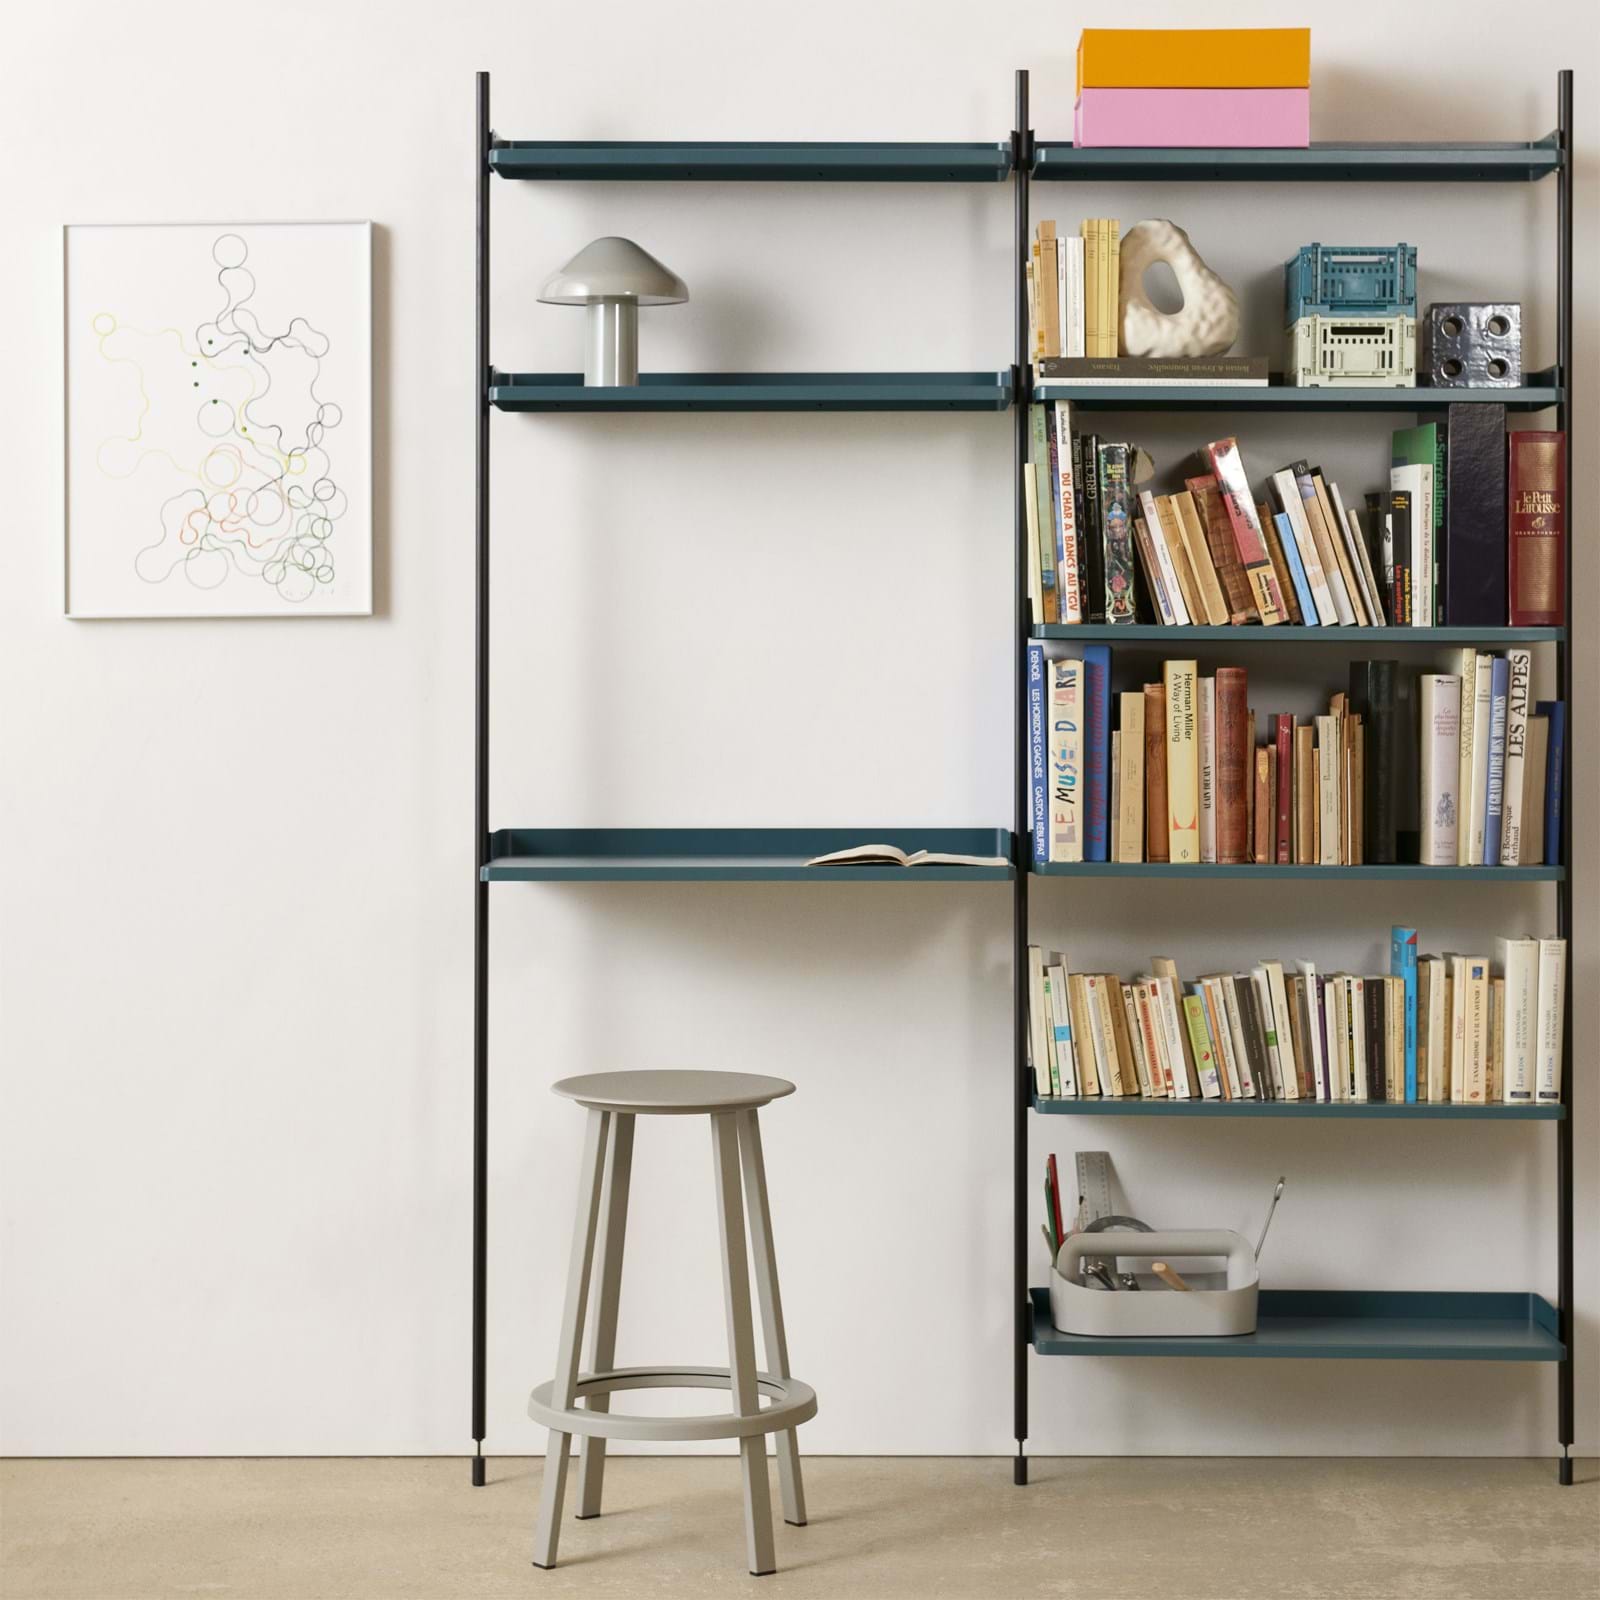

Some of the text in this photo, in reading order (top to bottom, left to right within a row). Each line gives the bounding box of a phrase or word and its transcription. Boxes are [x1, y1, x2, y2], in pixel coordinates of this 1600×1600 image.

[1061, 472, 1071, 487] DU
[1434, 442, 1446, 527] Surréalisme
[1062, 490, 1072, 520] CHAR
[1515, 499, 1561, 514] Larousse
[1523, 491, 1552, 504] le Petit
[1065, 535, 1075, 568] BANCS
[1067, 572, 1077, 587] AU
[1068, 590, 1078, 611] TGV
[1030, 650, 1041, 682] DENOËL
[1032, 688, 1041, 702] LES
[1171, 673, 1182, 743] A Way of Living
[1184, 673, 1193, 740] Herman Miller
[1508, 654, 1529, 759] LES ALPES
[1032, 702, 1042, 744] HORIZONS
[1035, 786, 1044, 821] GASTON
[1055, 809, 1077, 843] LE
[1502, 851, 1510, 862] R.
[1510, 826, 1520, 862] Arthaud
